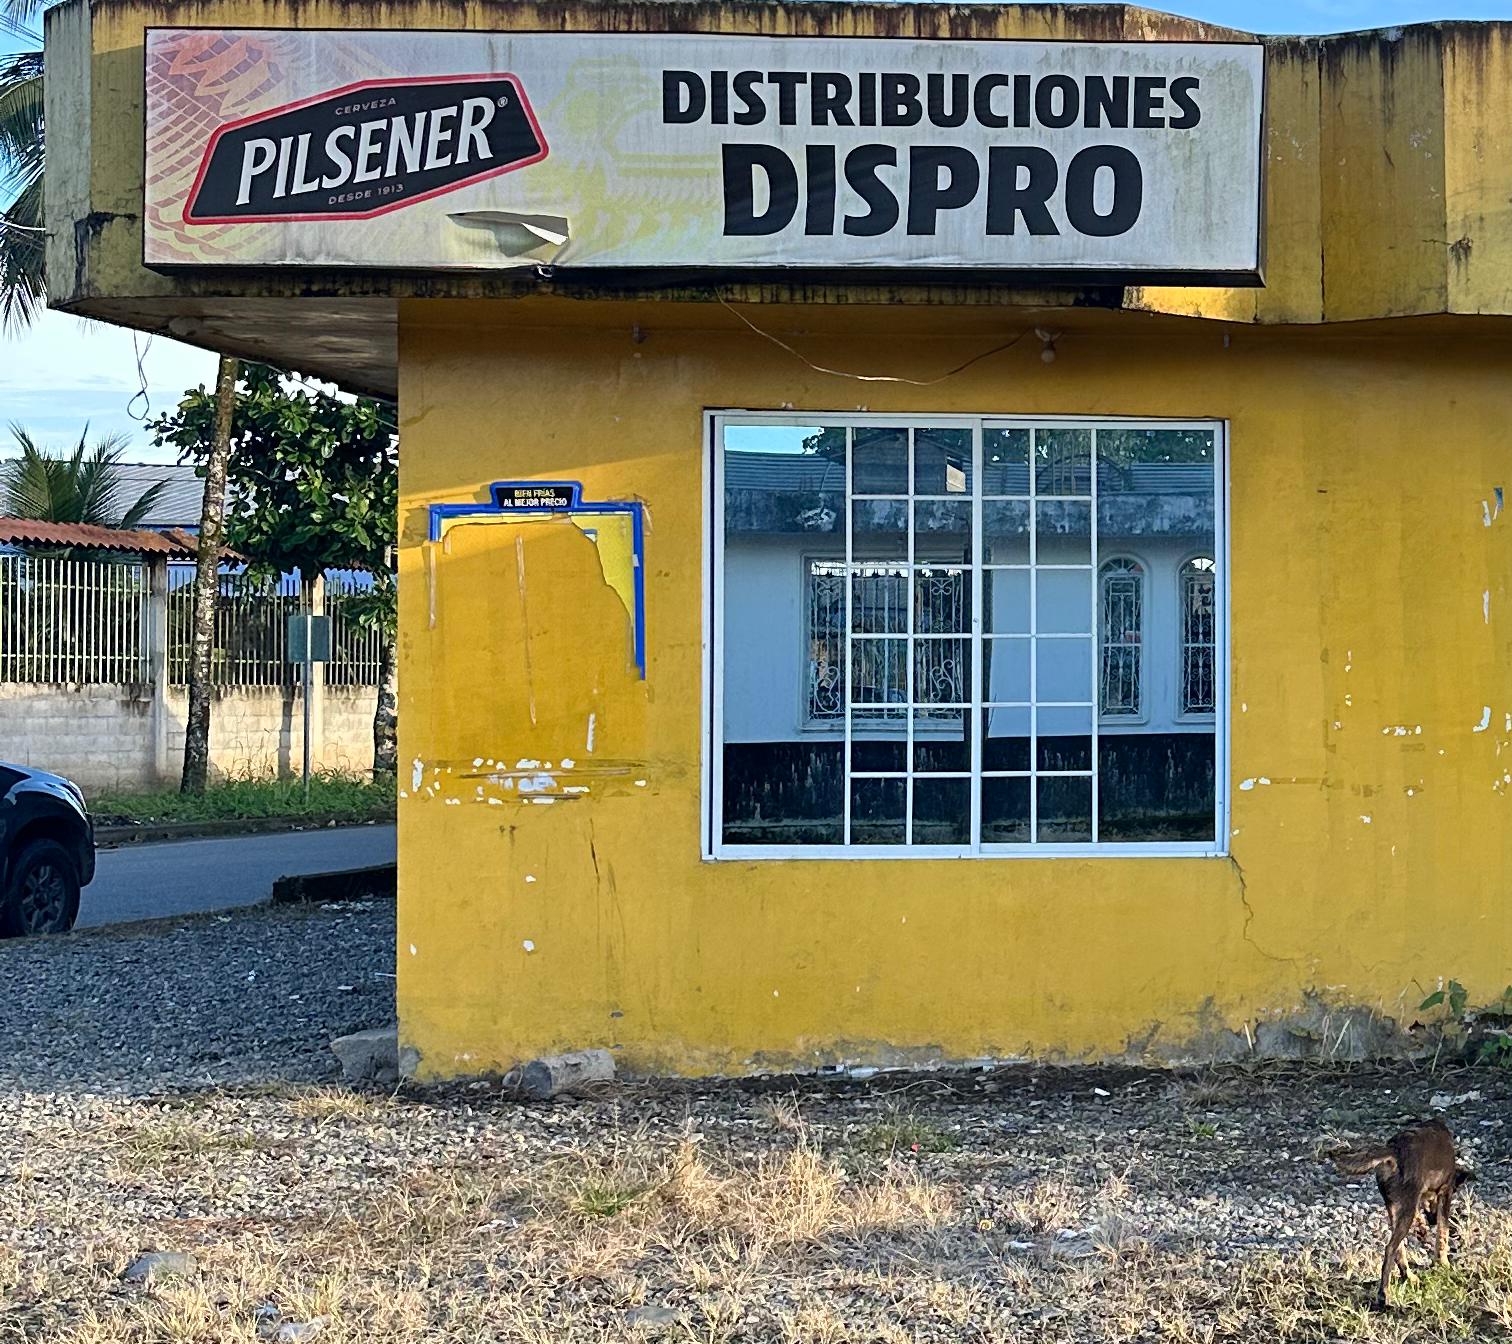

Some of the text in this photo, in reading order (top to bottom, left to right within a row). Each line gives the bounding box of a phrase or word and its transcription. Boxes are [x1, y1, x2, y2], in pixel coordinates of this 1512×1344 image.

[335, 97, 397, 116] CERVEZA
[662, 70, 1201, 129] DISTRIBUCIONES
[328, 189, 372, 205] DESDE
[721, 144, 1143, 237] DISPRO
[503, 497, 568, 507] AL MEJOR PRECIO
